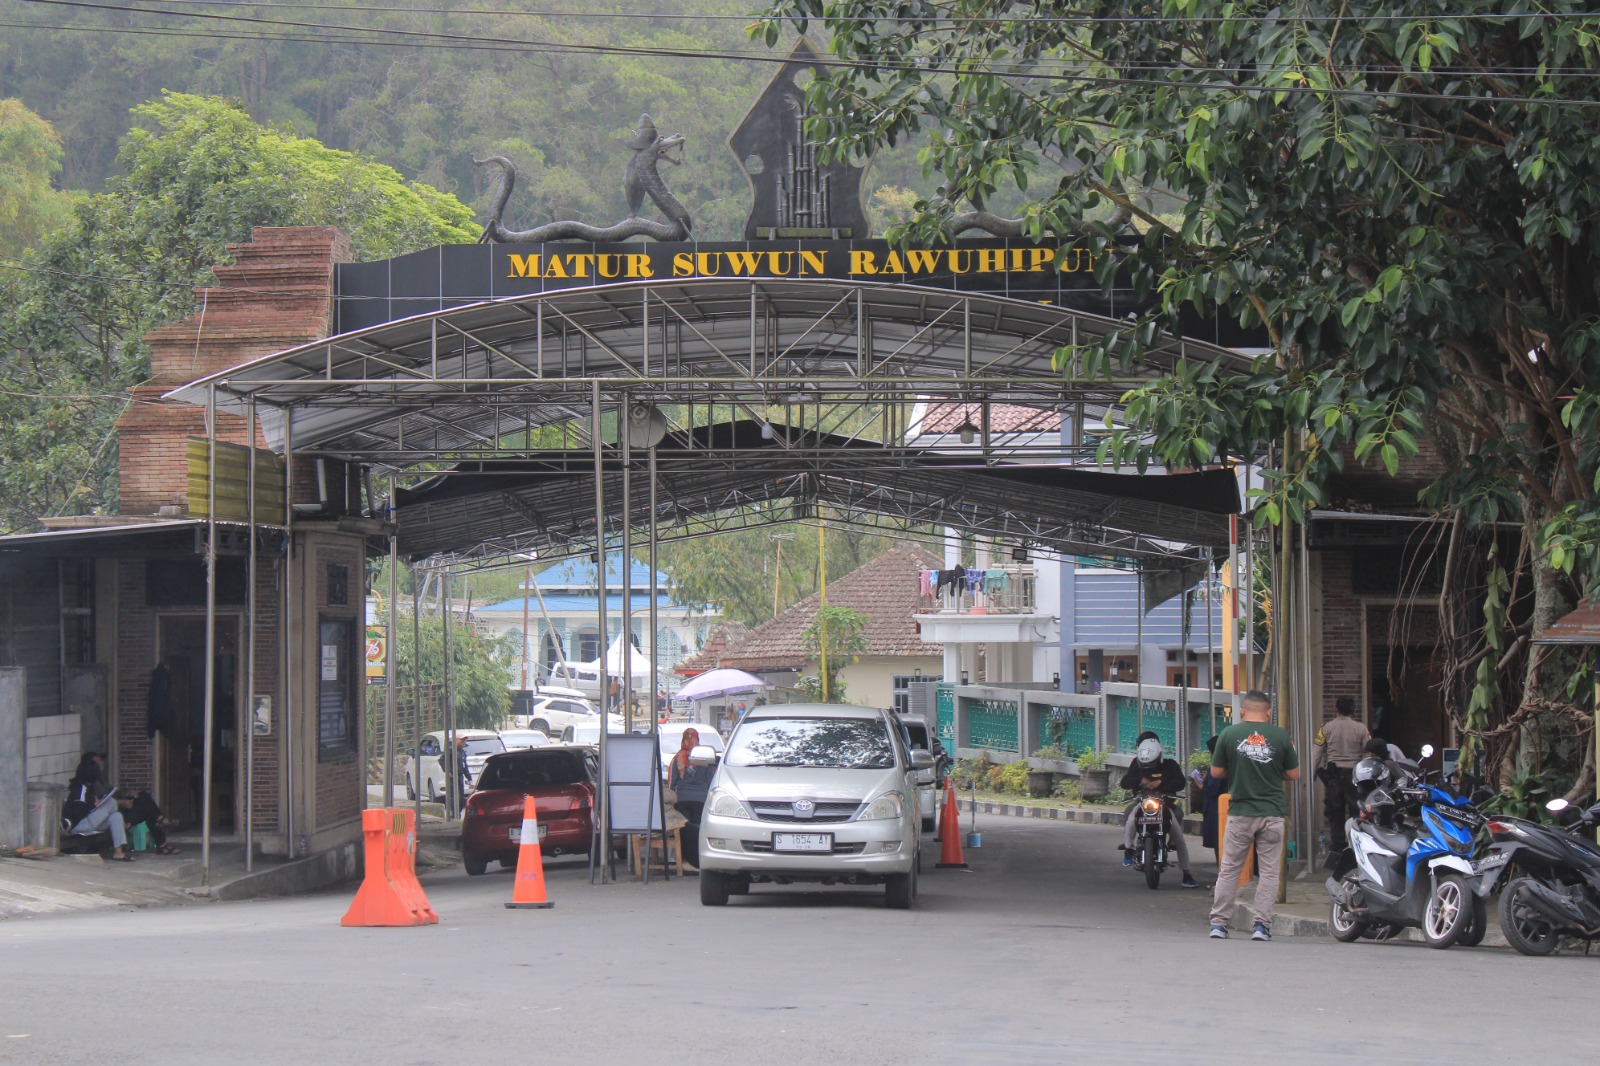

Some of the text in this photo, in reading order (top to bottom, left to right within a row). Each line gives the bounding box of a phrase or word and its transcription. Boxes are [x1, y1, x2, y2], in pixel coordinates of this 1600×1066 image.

[507, 253, 655, 279] MATUR
[672, 250, 828, 277] SUWUN
[777, 834, 829, 845] S 1654 AY
